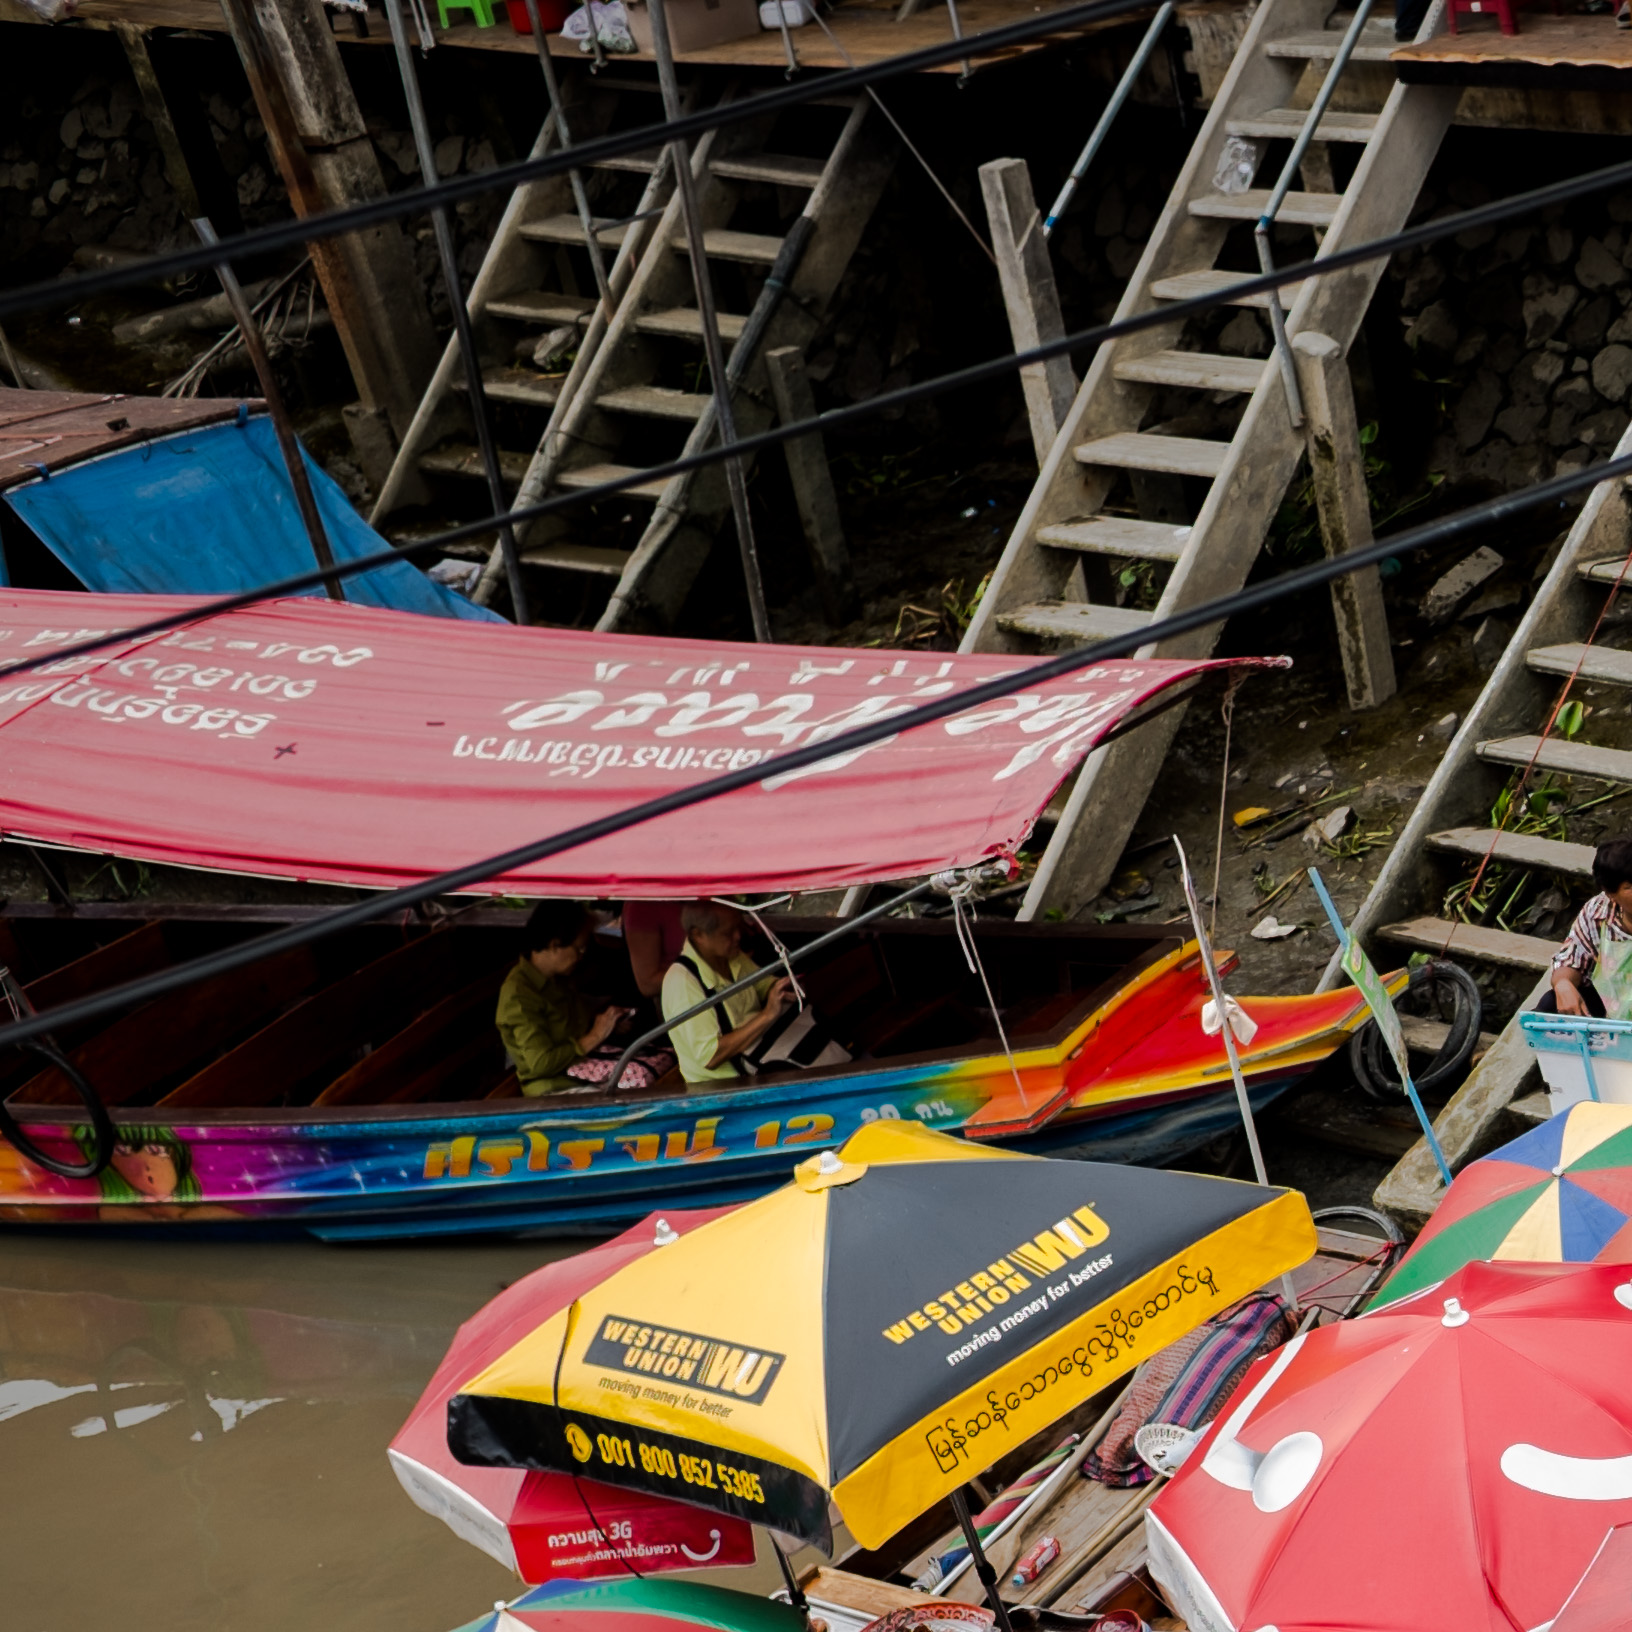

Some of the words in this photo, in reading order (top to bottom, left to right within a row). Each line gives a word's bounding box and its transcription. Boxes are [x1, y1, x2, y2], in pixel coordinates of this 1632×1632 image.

[754, 1114, 834, 1149] 12
[1015, 1204, 1111, 1272] WU
[882, 1257, 1017, 1345] WESTERN
[937, 1271, 1032, 1335] UNION
[945, 1325, 1003, 1367] moving
[999, 1295, 1049, 1332] money
[1047, 1280, 1071, 1302] for
[1067, 1253, 1114, 1287] better
[602, 1320, 708, 1360] WESTERN
[623, 1346, 698, 1381] UNION
[599, 1376, 641, 1399] moving
[642, 1385, 682, 1409] money
[682, 1392, 699, 1410] for
[699, 1396, 734, 1418] better
[706, 1345, 775, 1397] WU
[597, 1433, 636, 1469] 001
[639, 1442, 677, 1479] 800
[678, 1453, 718, 1490] 852
[716, 1463, 766, 1504] 5385
[609, 1520, 633, 1540] 3G
